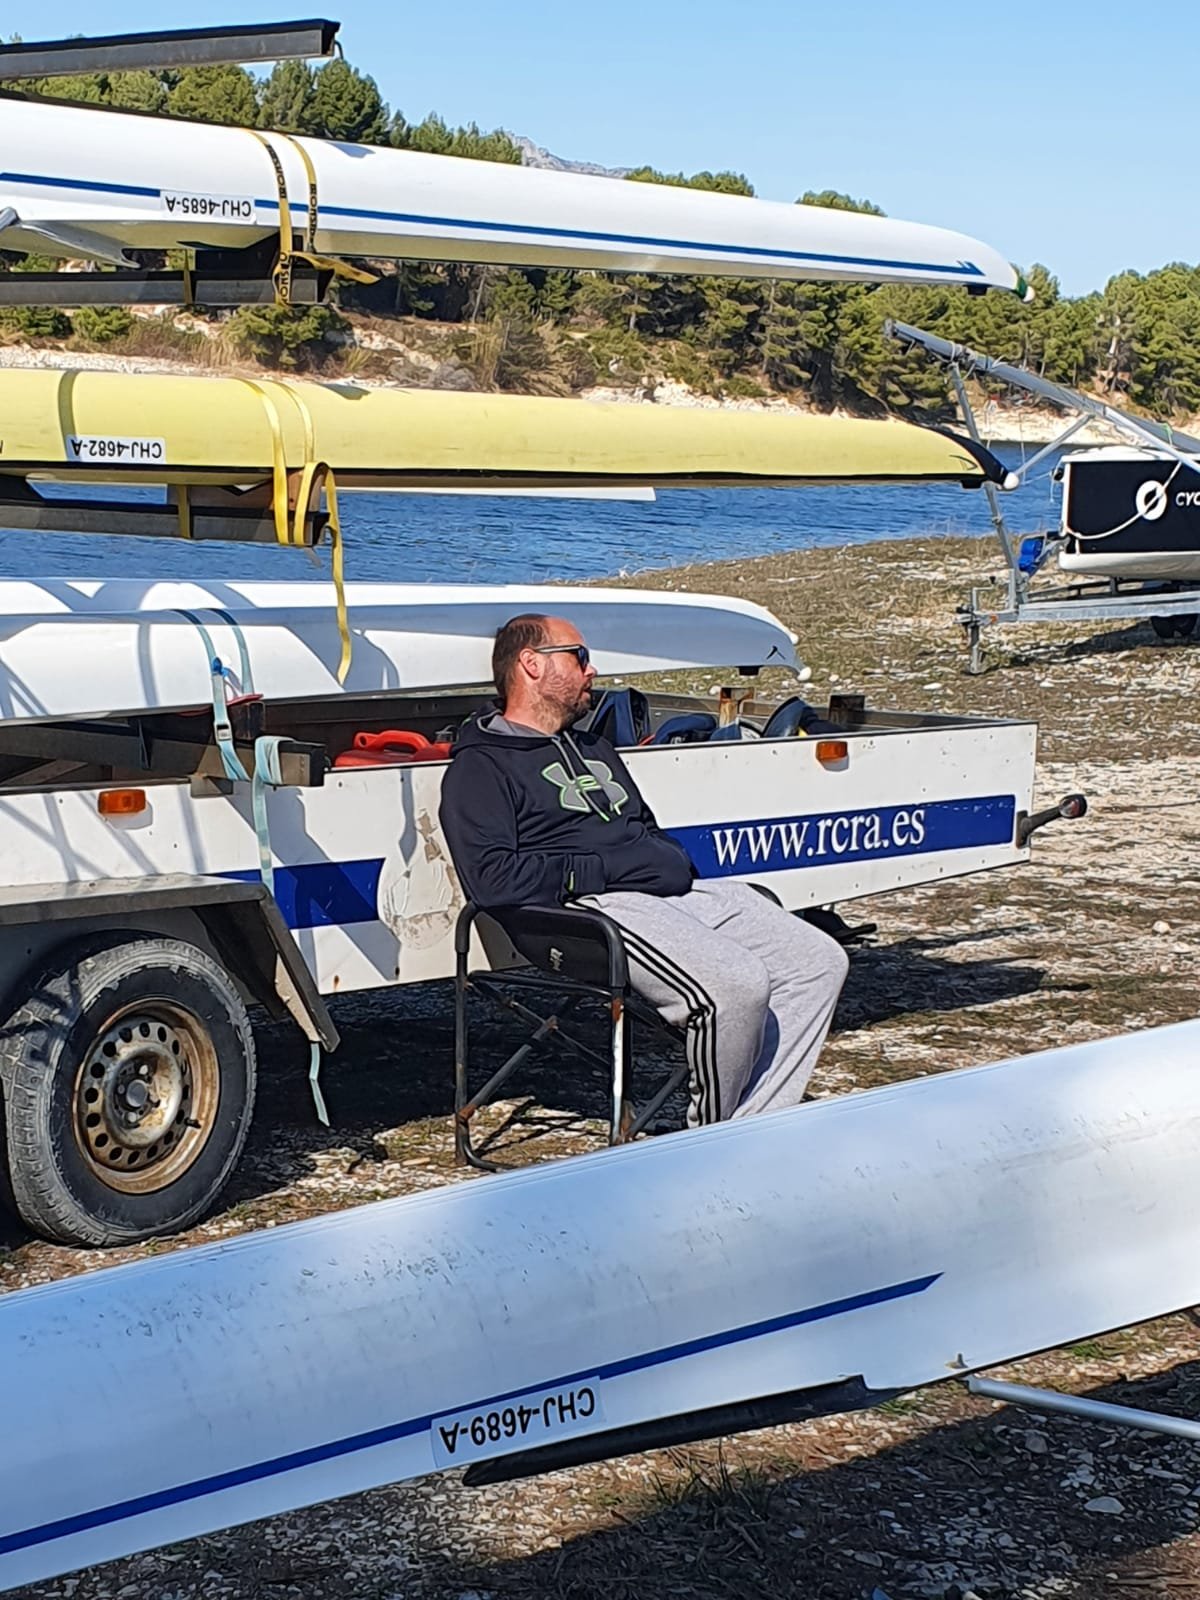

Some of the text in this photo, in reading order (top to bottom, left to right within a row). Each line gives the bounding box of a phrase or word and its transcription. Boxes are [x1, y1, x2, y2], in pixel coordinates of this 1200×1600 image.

[165, 196, 252, 217] CHJ-4685-A
[70, 439, 163, 459] CHJ-4682-A
[712, 808, 925, 867] www.rcra.es
[439, 1387, 595, 1454] CHJ-4689-A
